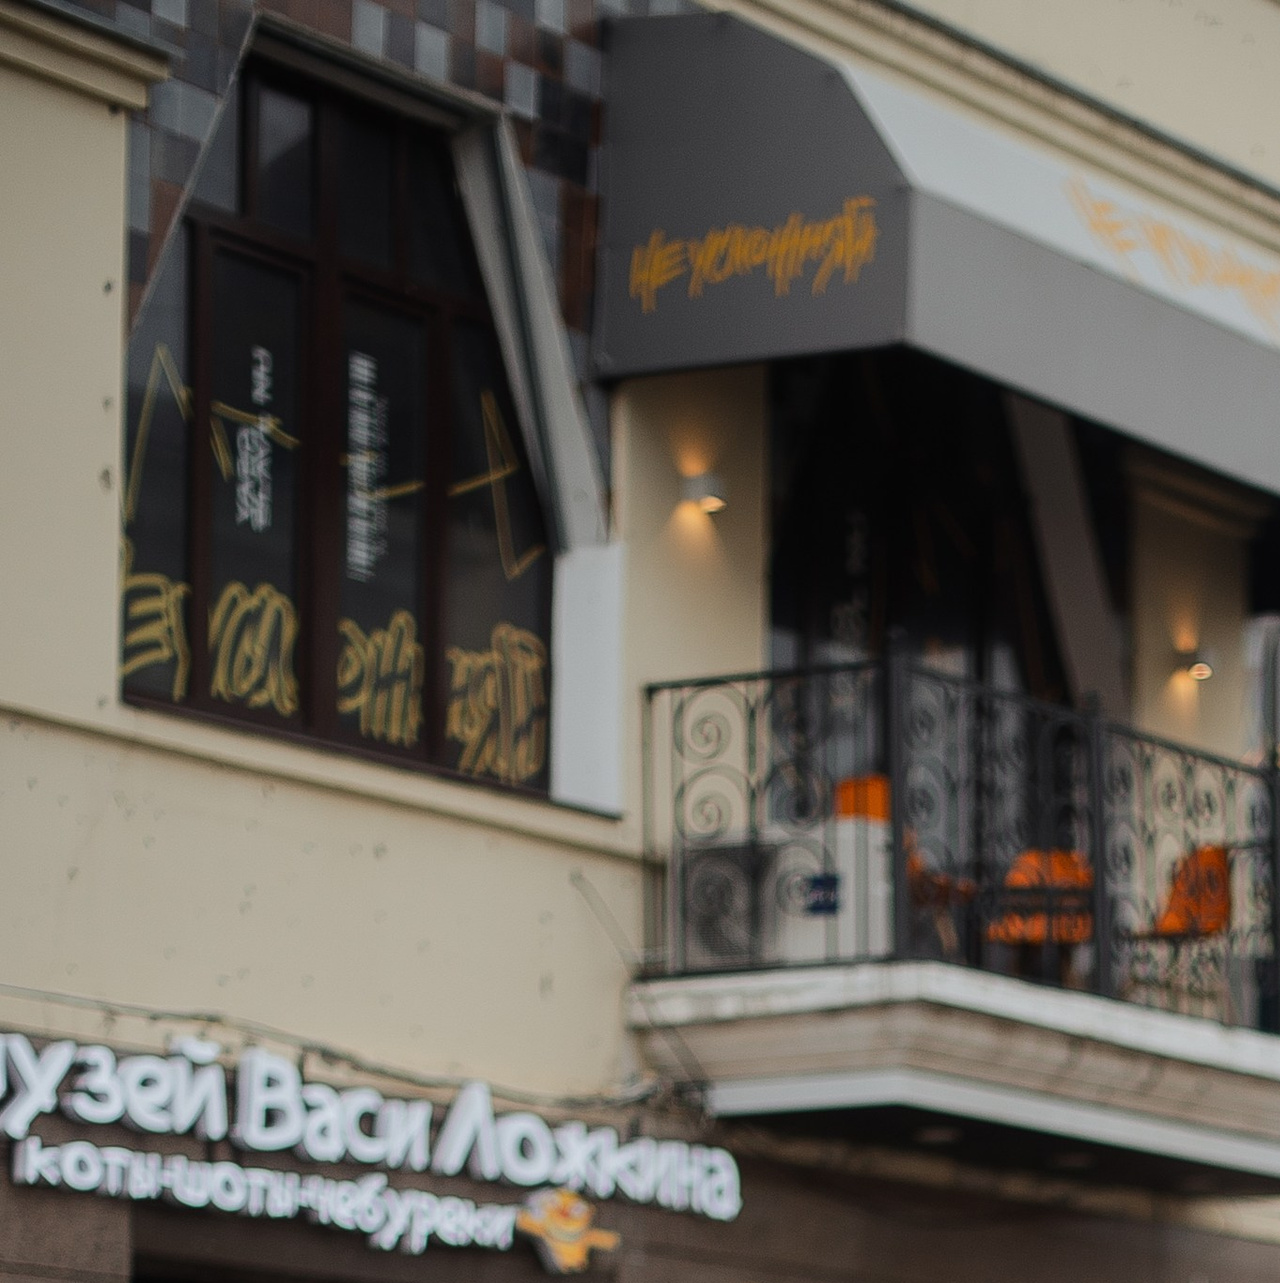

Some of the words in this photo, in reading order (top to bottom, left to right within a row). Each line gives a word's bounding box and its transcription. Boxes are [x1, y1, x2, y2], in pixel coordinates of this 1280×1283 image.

[0, 1033, 228, 1141] узей
[232, 1047, 432, 1172] Васи
[433, 1078, 743, 1222] Ложкина
